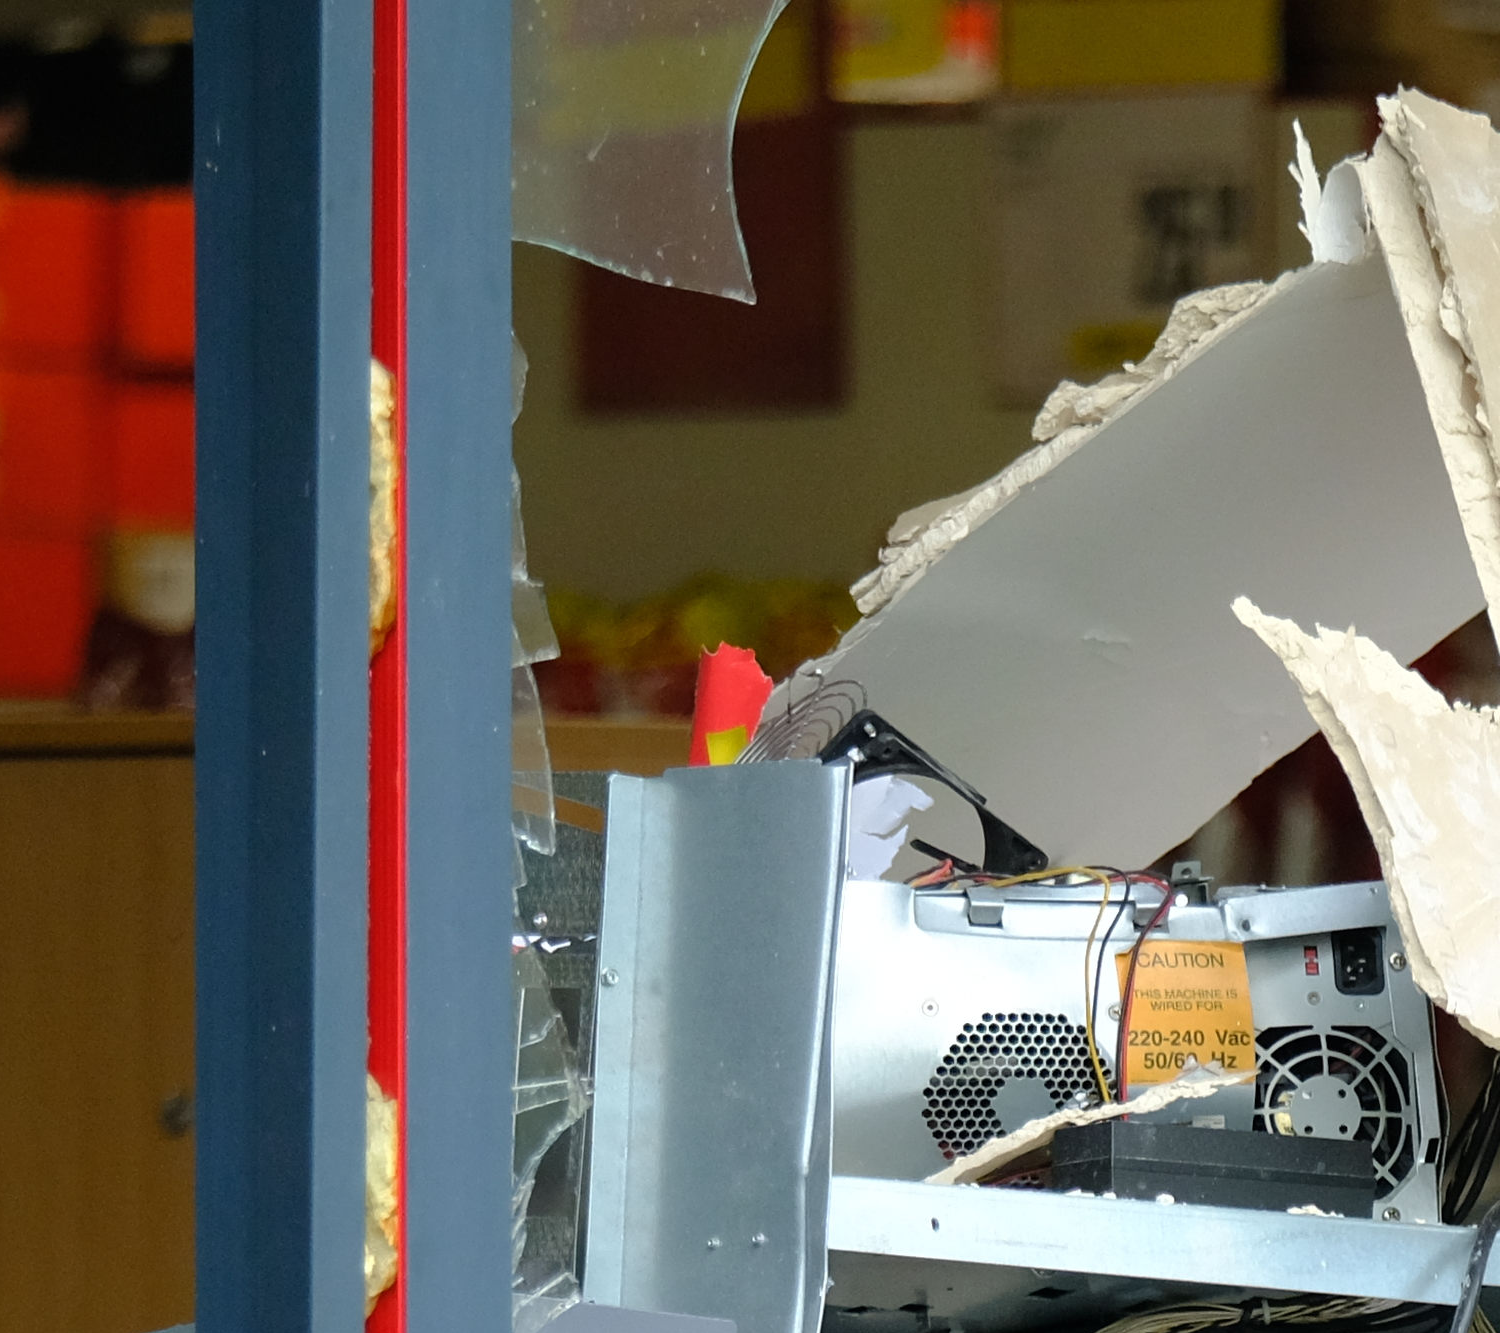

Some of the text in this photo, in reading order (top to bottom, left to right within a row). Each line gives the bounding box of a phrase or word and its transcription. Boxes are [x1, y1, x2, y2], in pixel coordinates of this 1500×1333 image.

[1136, 952, 1225, 969] CAUTION
[1134, 988, 1238, 999] THIS MACHINE IS
[1150, 1001, 1224, 1012] WIRED FOR
[1128, 1029, 1251, 1047] 220-240 Vac
[1211, 1051, 1238, 1069] Hz
